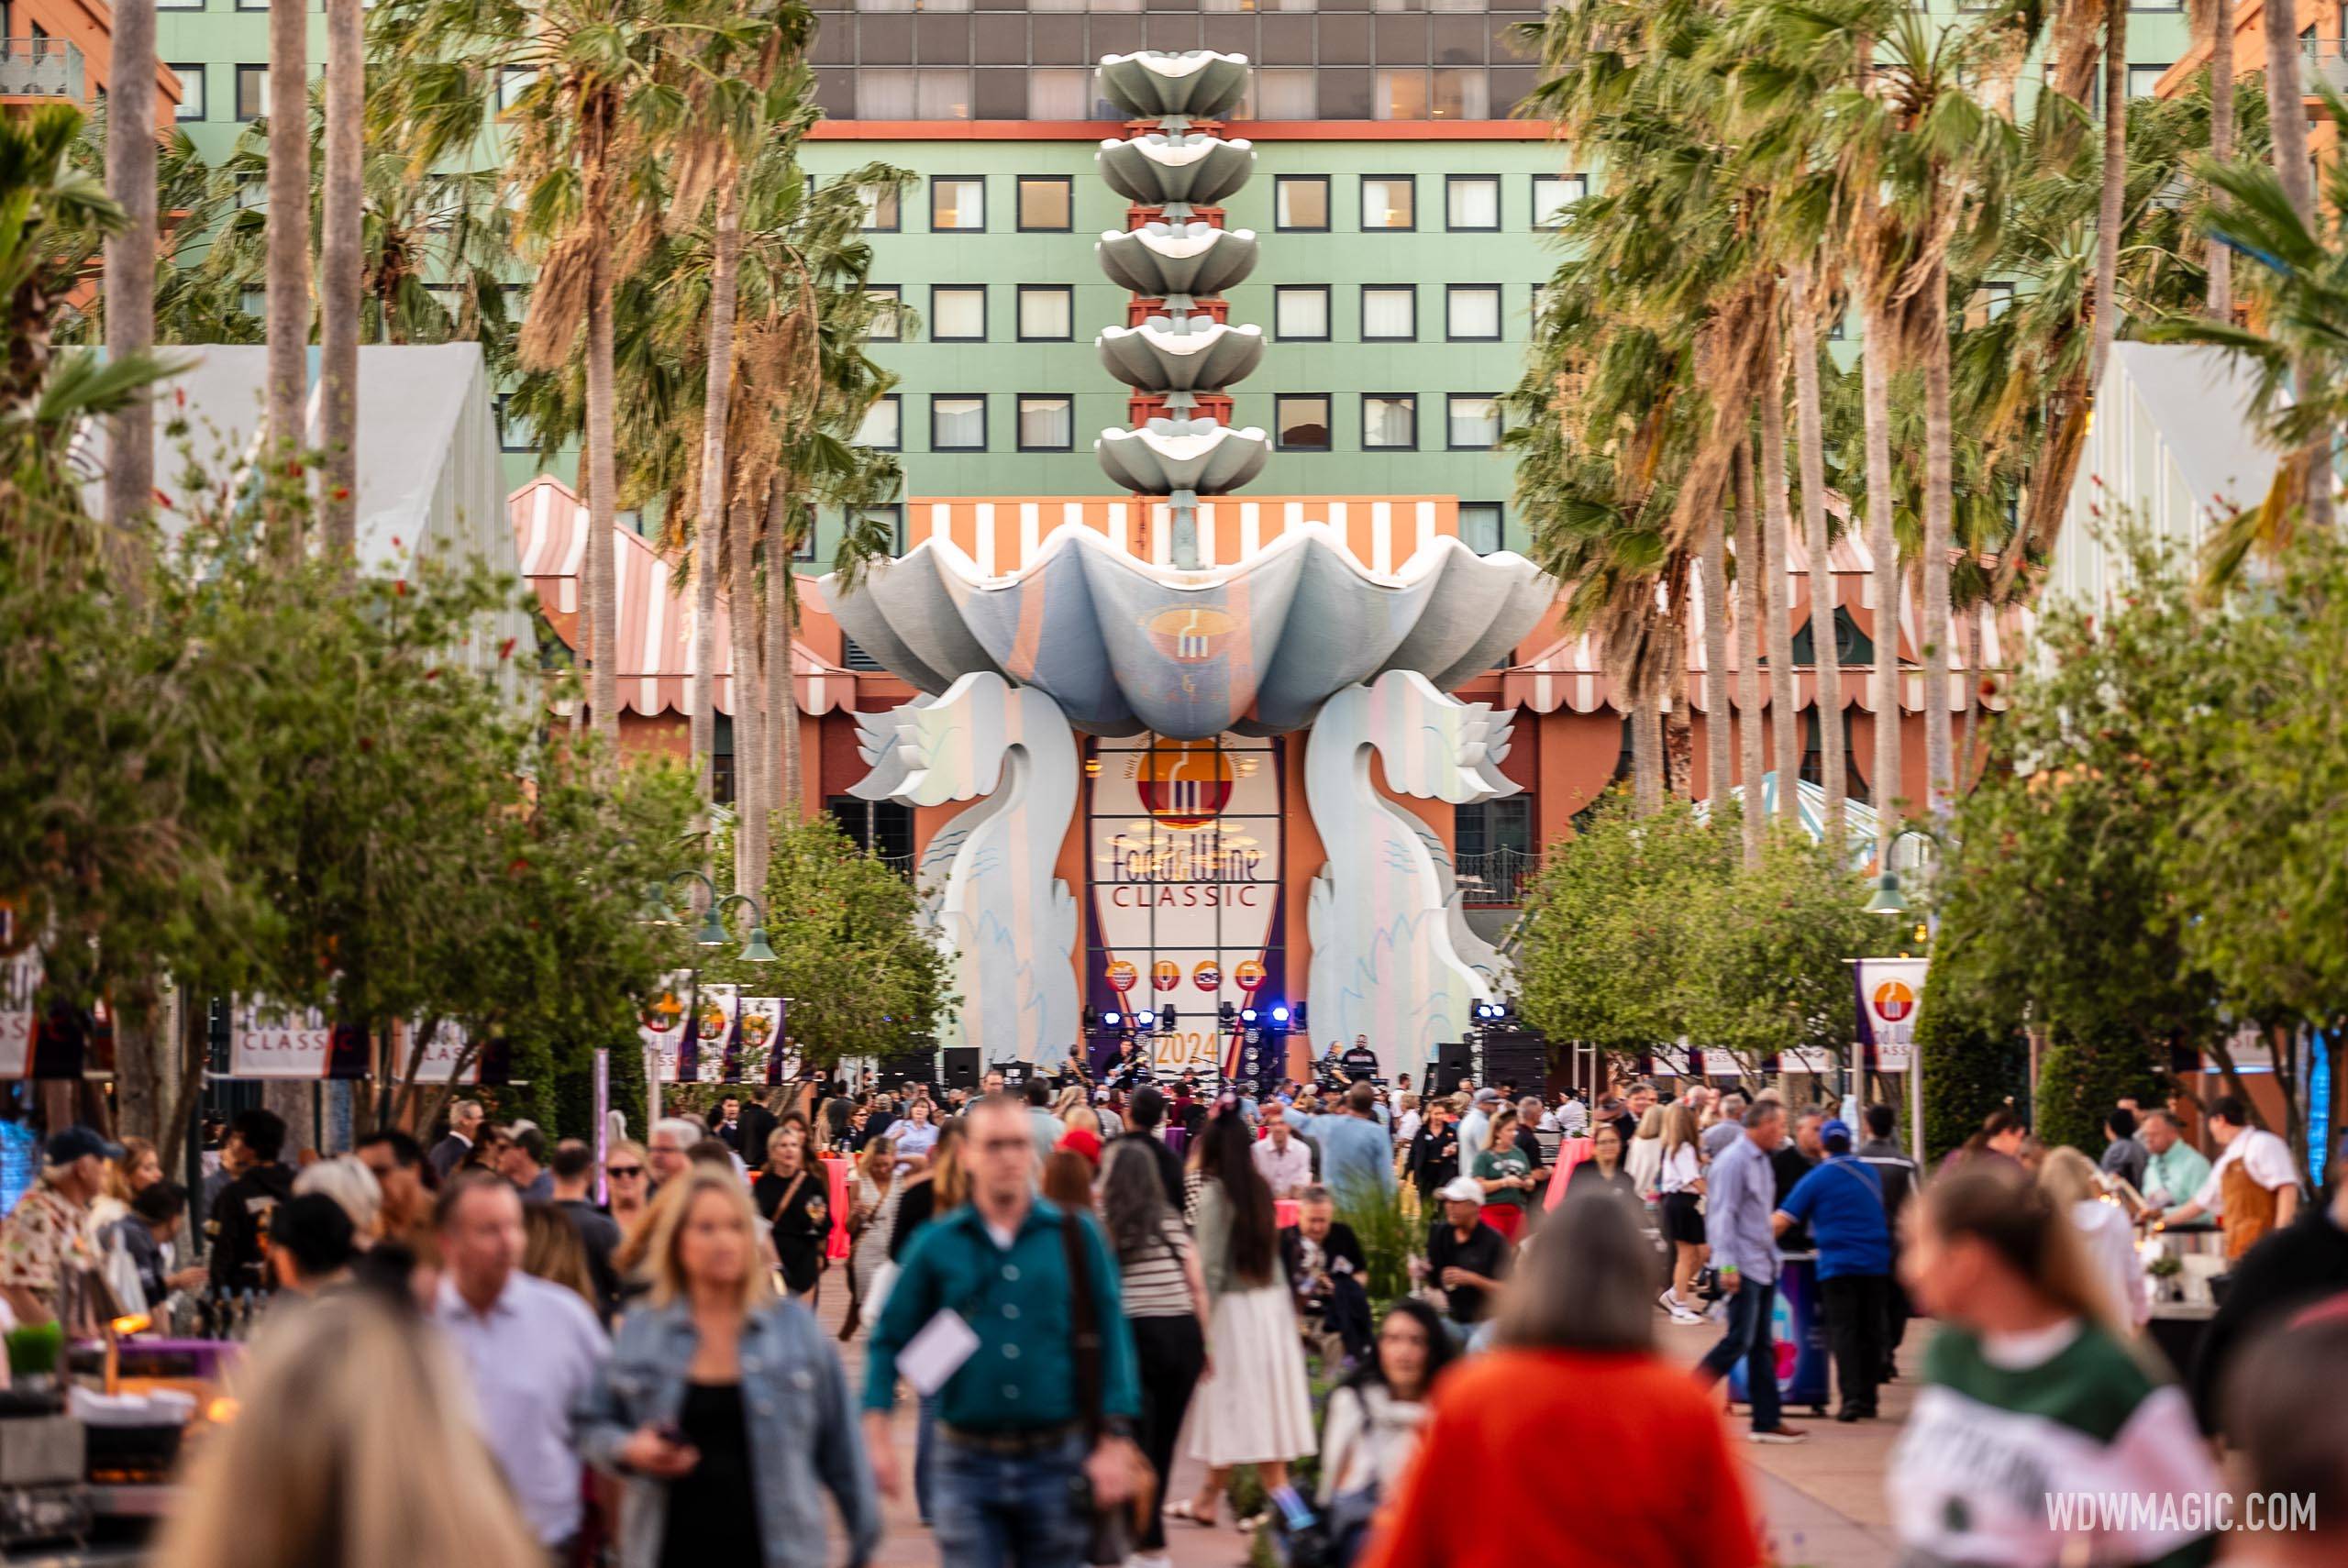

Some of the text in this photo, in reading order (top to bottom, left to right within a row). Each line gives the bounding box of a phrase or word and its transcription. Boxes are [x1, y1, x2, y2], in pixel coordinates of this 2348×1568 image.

[1113, 834, 1174, 881] Food
[1191, 834, 1260, 881] Wine
[1113, 885, 1257, 908] CLASSIC
[1154, 1032, 1219, 1064] 2024
